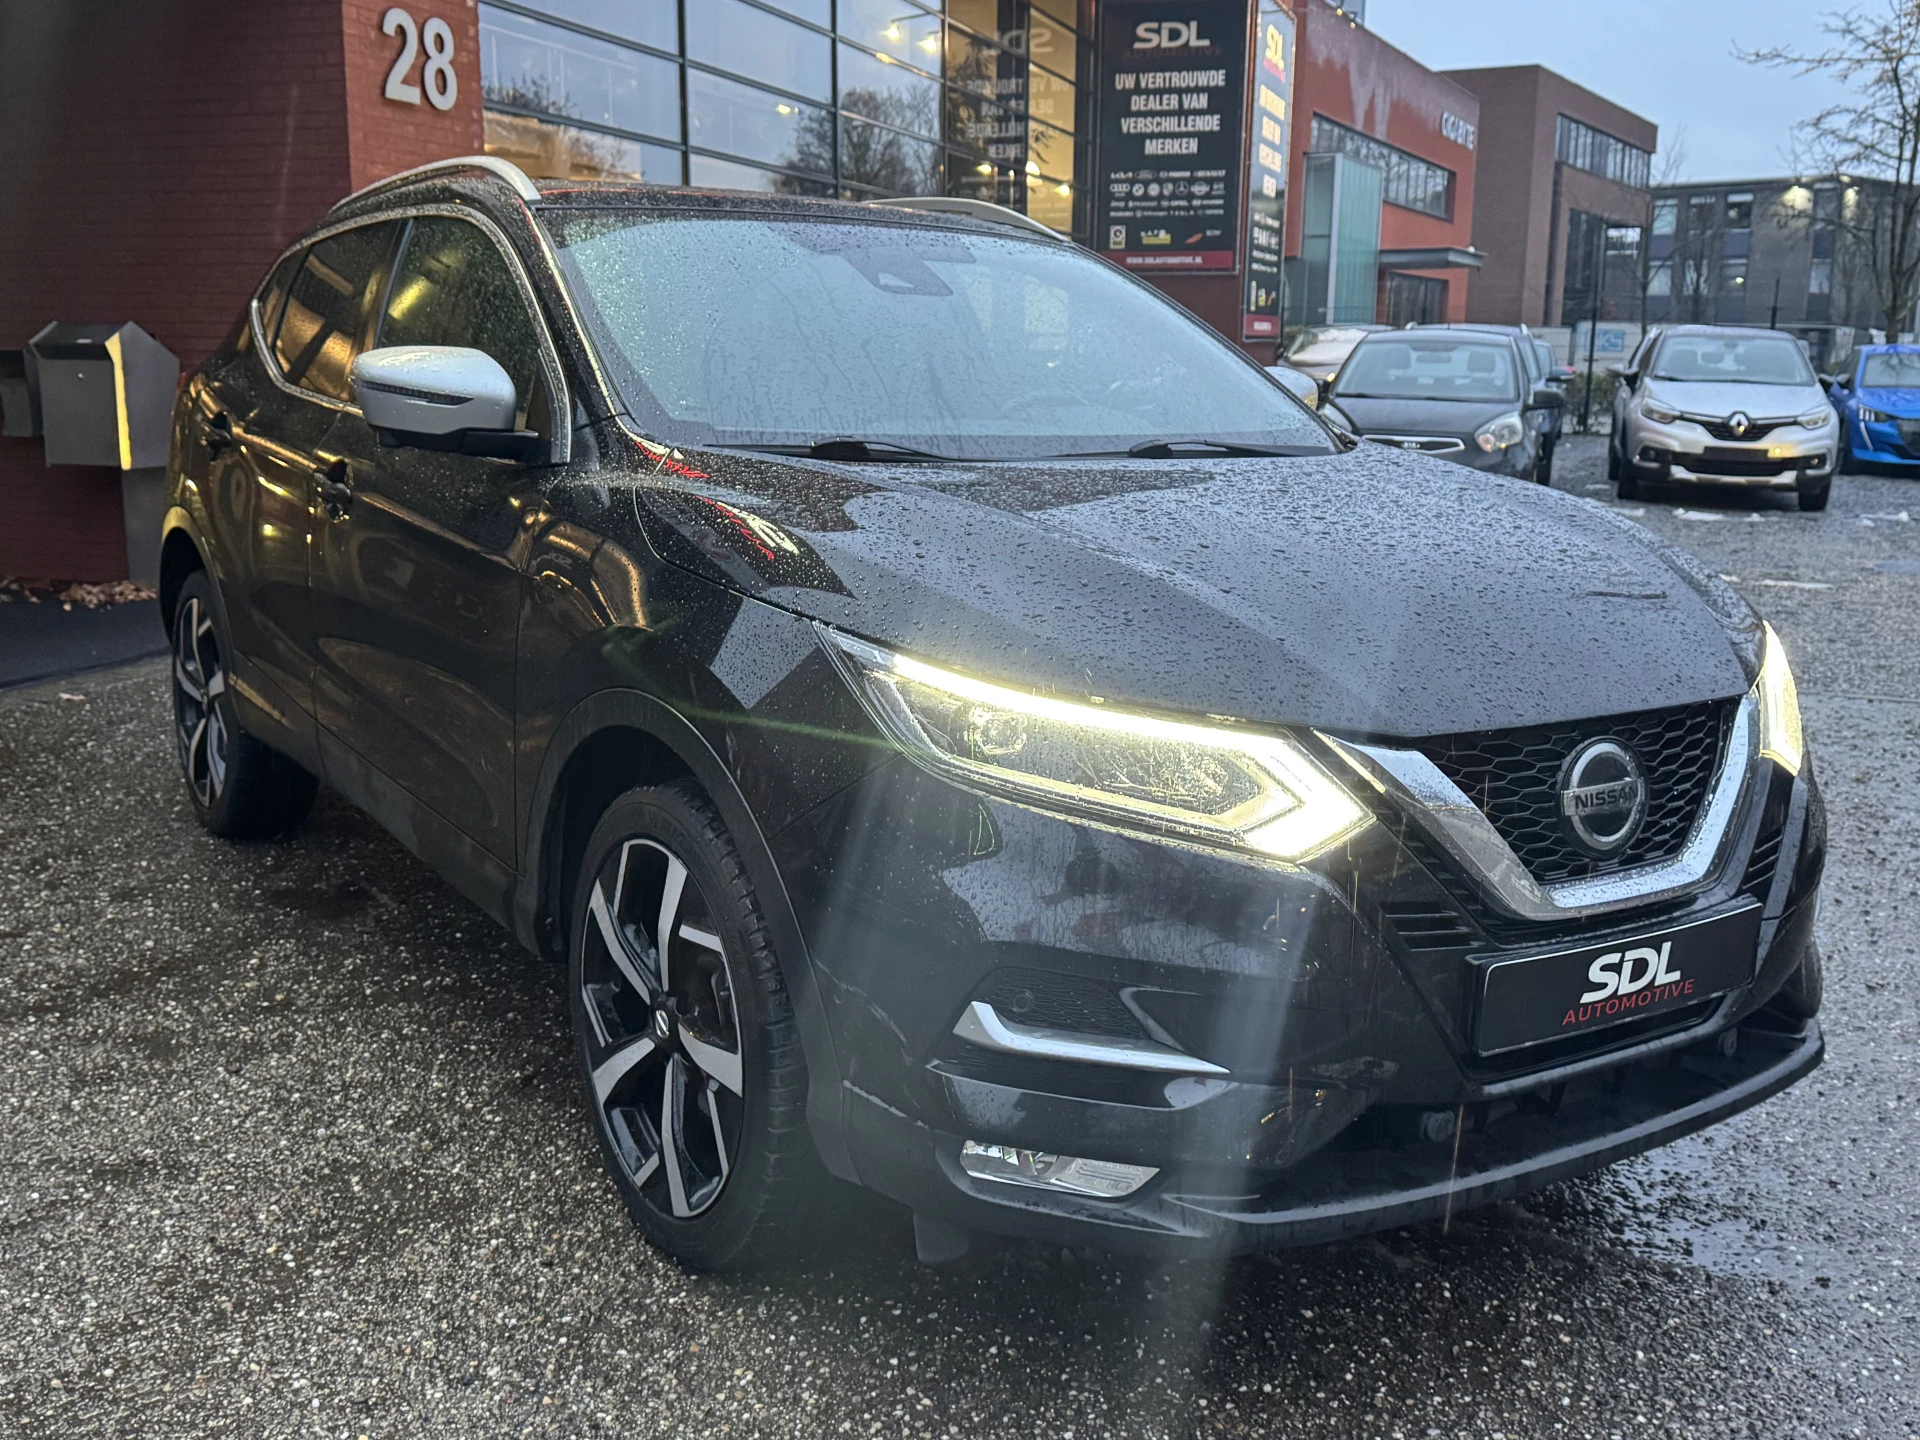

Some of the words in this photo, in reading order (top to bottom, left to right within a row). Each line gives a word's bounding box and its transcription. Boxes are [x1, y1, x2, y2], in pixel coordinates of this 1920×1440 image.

[1133, 21, 1210, 48] SDL
[382, 7, 458, 111] 28
[1115, 73, 1136, 90] UW
[1139, 70, 1226, 89] VERTROUWDE
[1131, 94, 1179, 111] DEALER
[1182, 93, 1208, 110] VAN
[1121, 114, 1221, 134] VERSCHILLENDE
[1145, 137, 1198, 155] MERKEN
[1574, 785, 1638, 810] NISSAN
[1579, 940, 1682, 1004] SDL
[1562, 979, 1695, 1026] AUTOMOTIVE
